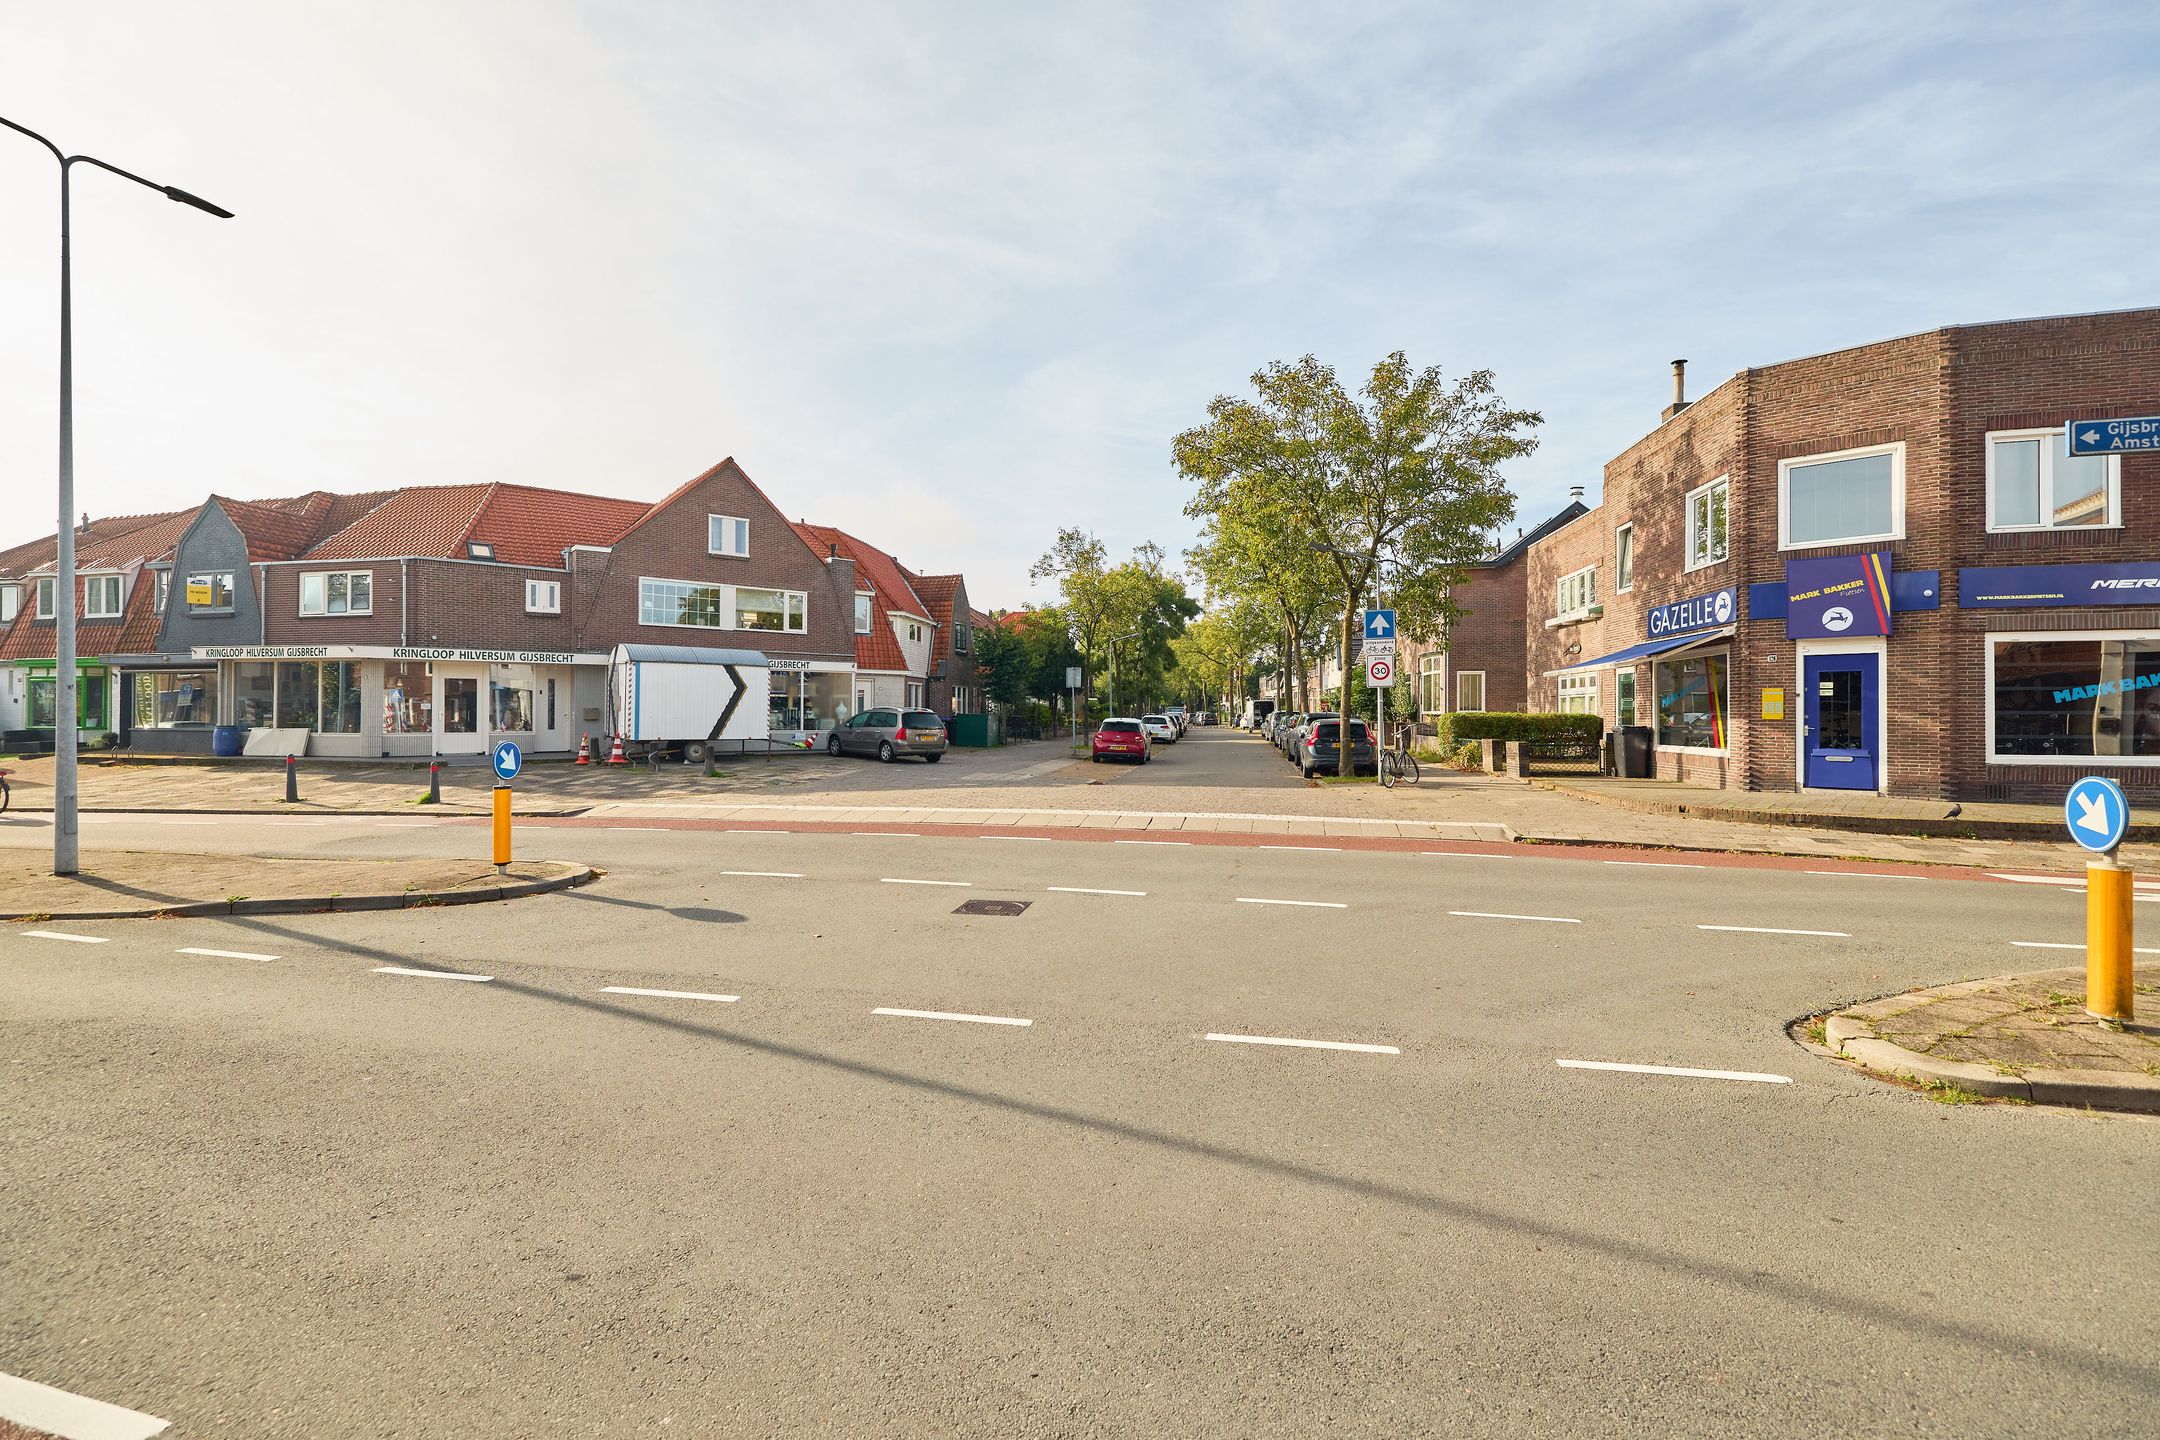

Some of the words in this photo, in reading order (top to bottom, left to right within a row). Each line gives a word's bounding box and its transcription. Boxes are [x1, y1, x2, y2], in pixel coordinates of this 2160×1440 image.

[2107, 421, 2160, 437] Gijsbr
[2110, 434, 2160, 449] Amst
[1790, 590, 1820, 602] MARK
[1823, 579, 1864, 595] BAKKER
[1651, 597, 1712, 633] GAZELLE
[205, 647, 244, 658] KRINGLOOP
[246, 647, 284, 657] HILVERSUM
[286, 647, 328, 657] GIJSBRECHT
[393, 648, 455, 660] KRINGLOOP
[459, 651, 515, 661] HILVERSUM
[519, 652, 575, 663] GIJSBRECHT
[768, 660, 810, 669] GIJSBRECHT
[2053, 681, 2117, 704] MARK
